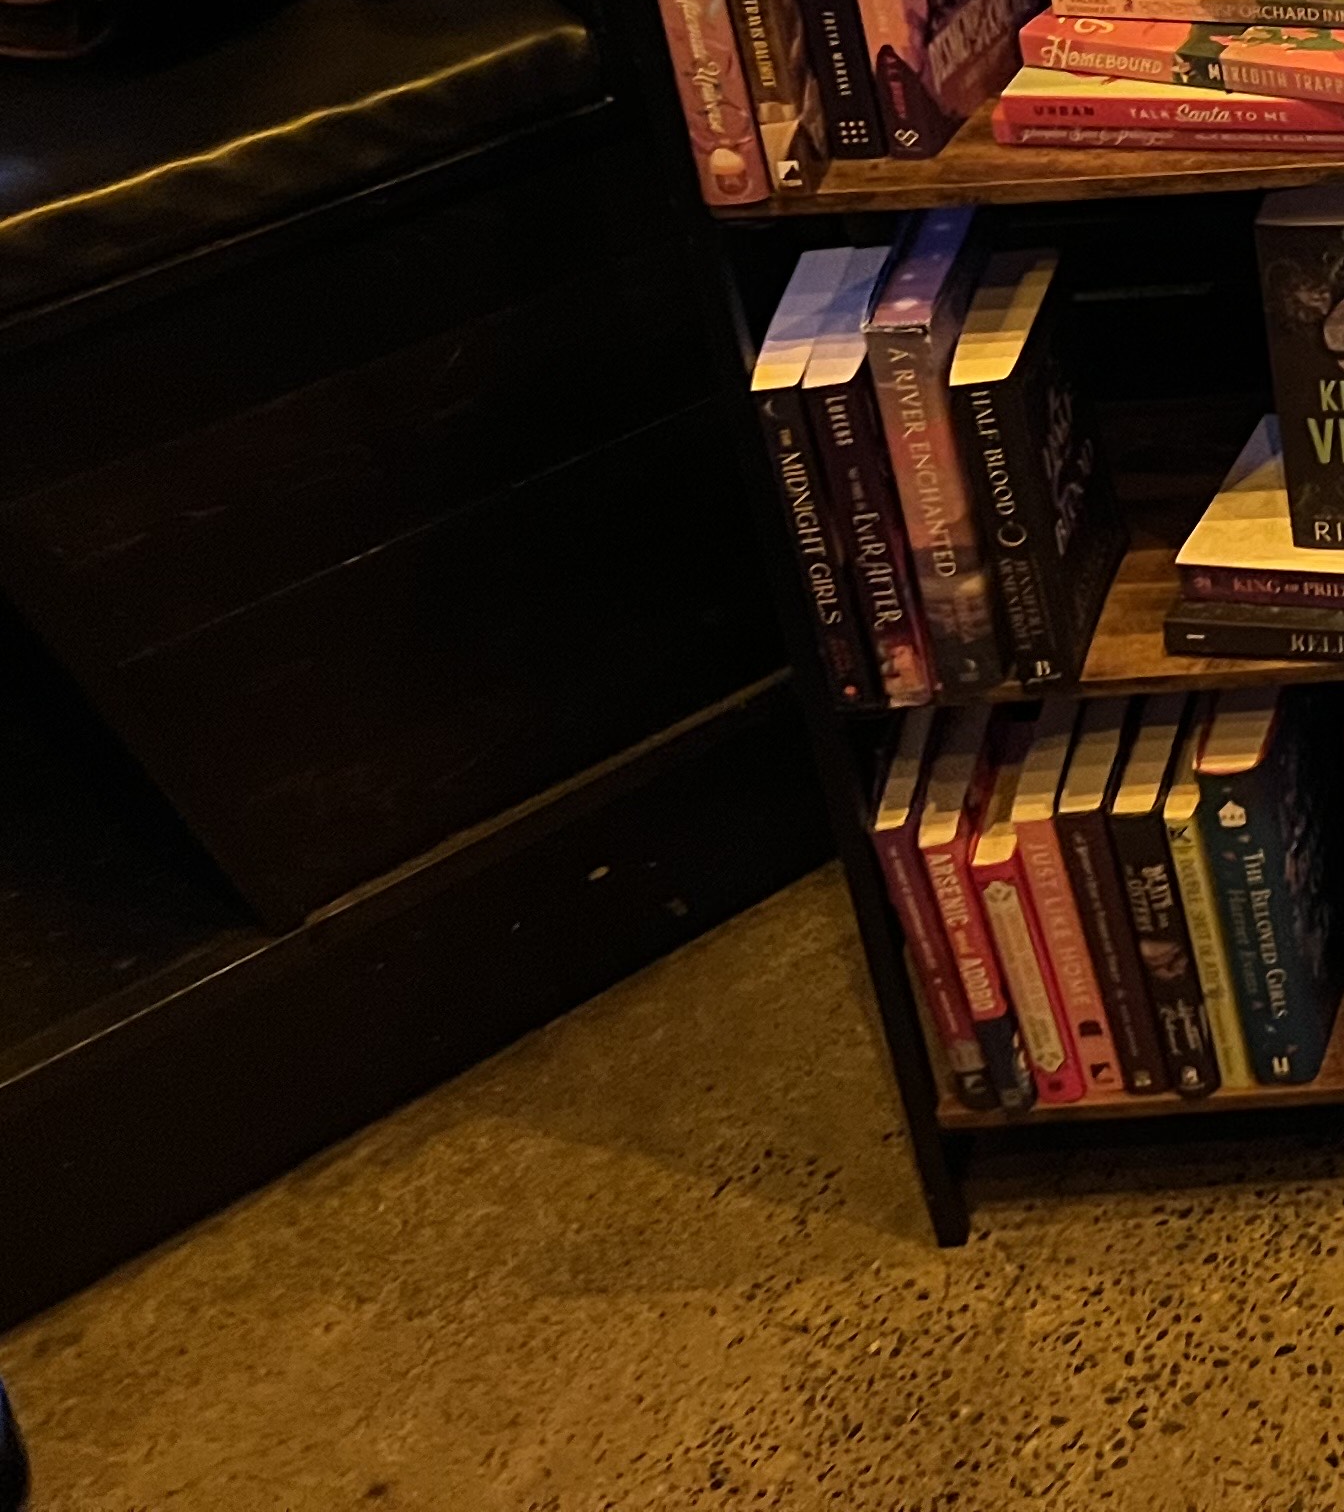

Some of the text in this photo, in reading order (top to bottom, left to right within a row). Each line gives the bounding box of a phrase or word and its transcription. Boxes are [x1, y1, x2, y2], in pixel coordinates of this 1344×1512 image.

[1239, 3, 1318, 22] ORCHARD
[1033, 104, 1289, 123] URBAN TALK Santa TO ME
[888, 348, 957, 578] A RIVER ENCHANTED
[969, 390, 1016, 517] HALF BLOOD
[780, 451, 842, 626] MIDNIGHT GIRLS
[1242, 847, 1289, 1018] THE BELOVED GIRLS
